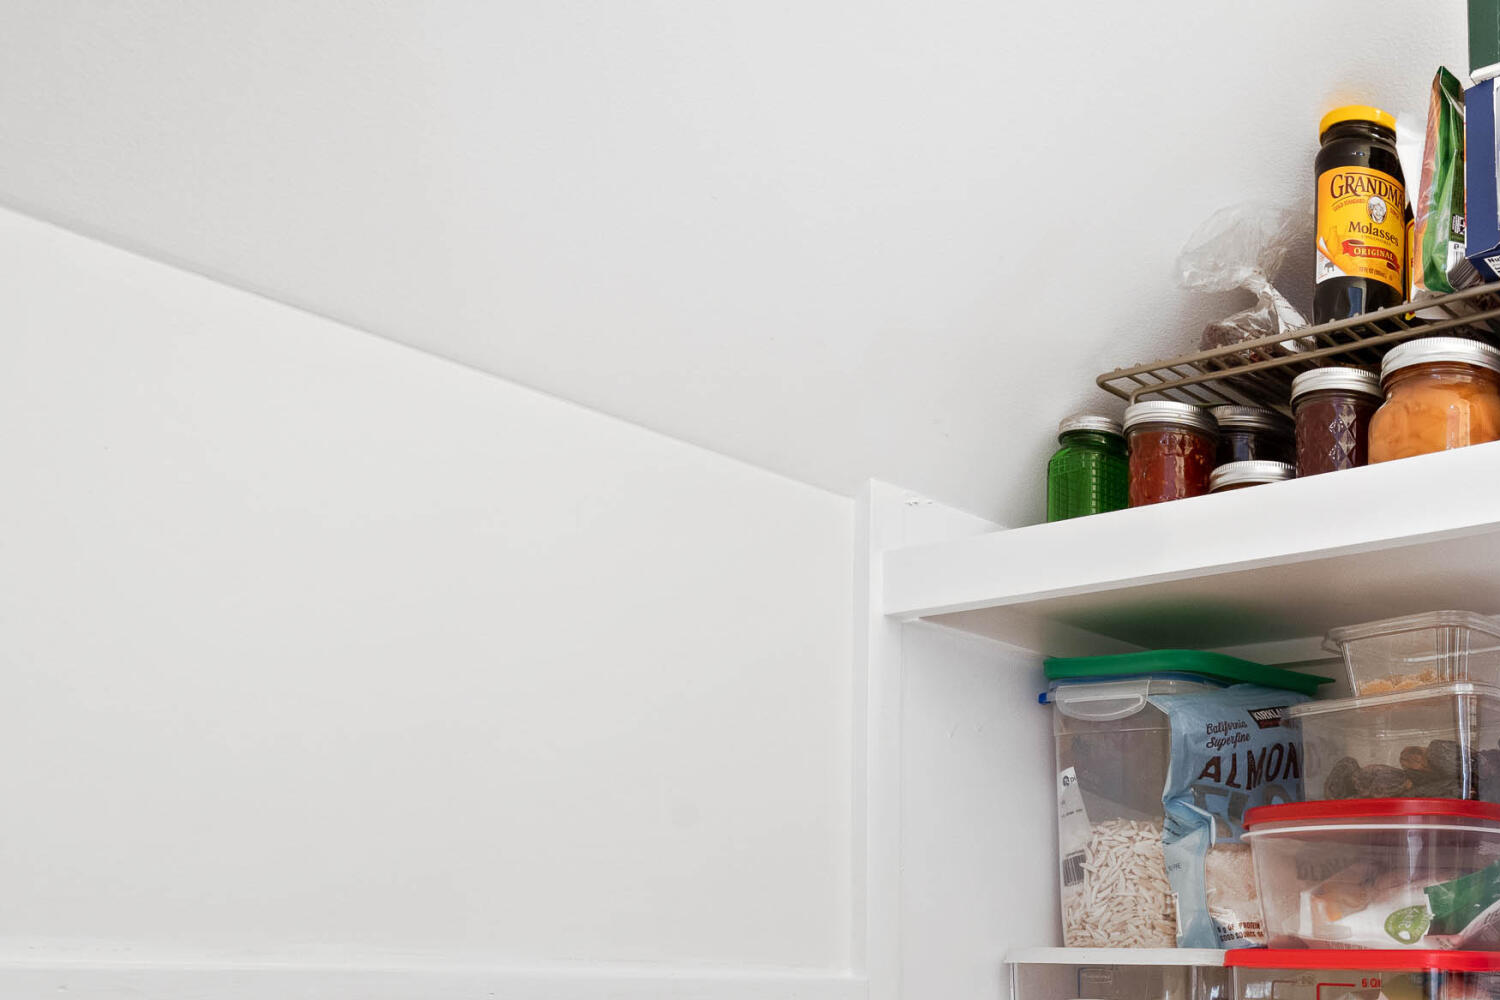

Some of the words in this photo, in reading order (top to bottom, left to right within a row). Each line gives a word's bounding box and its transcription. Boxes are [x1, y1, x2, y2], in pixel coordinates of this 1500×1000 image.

[1348, 221, 1399, 246] Molasses
[1353, 247, 1394, 261] ORIGINAL
[1206, 720, 1248, 735] California
[1206, 732, 1250, 751] Superfine
[1369, 979, 1382, 988] Qt
